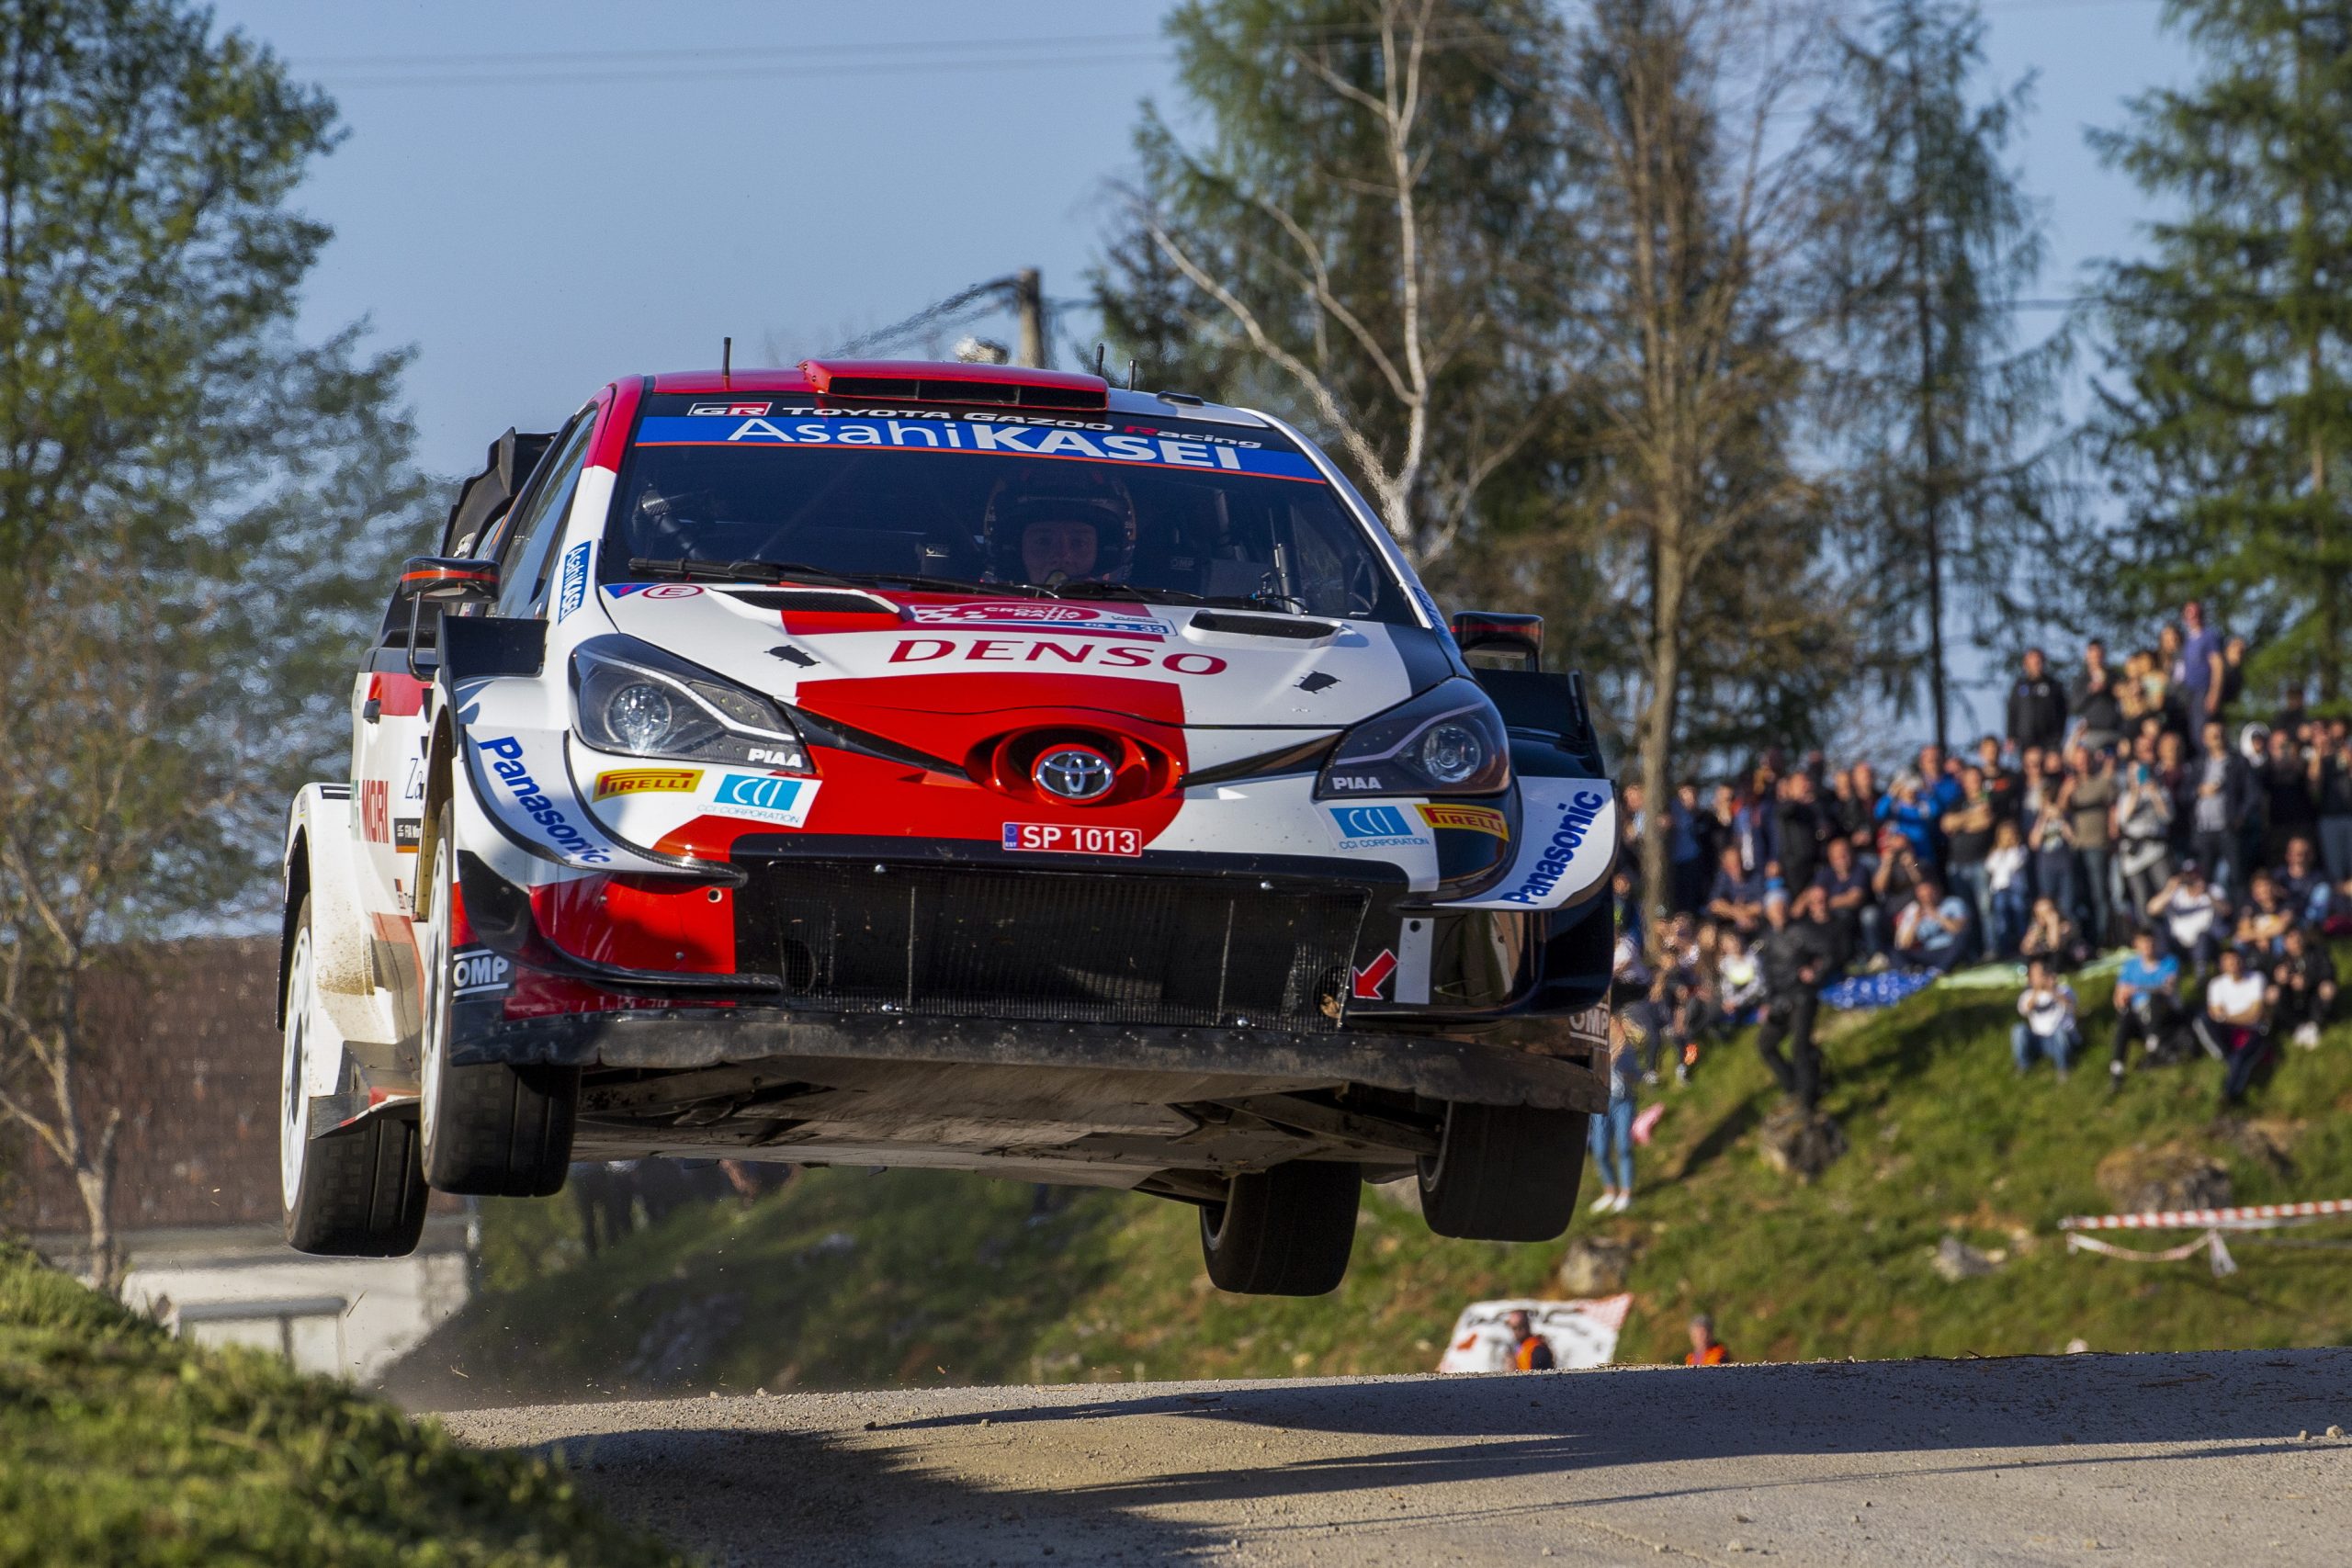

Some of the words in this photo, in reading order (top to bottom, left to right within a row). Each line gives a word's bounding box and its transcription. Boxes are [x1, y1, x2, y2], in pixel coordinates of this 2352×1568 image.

[689, 405, 768, 416] GR
[783, 407, 952, 419] TOYOTA
[963, 412, 1114, 432] GAZOO
[1124, 425, 1262, 449] Racing
[1139, 625, 1165, 634] 33
[888, 638, 1227, 676] DENSO
[748, 748, 803, 768] PIAA
[598, 771, 695, 795] PIRELLI
[732, 778, 783, 807] CCI
[1332, 777, 1382, 790] PIAA
[478, 736, 611, 863] Panasonic
[696, 804, 720, 814] CCI
[721, 806, 800, 824] CORPORATION
[1349, 808, 1396, 835] CCI
[1423, 807, 1504, 834] PIRELLI
[1023, 825, 1062, 849] SP
[1070, 828, 1136, 853] 1013
[1339, 840, 1359, 850] CCI
[1360, 837, 1430, 848] CORPORATION
[1499, 791, 1603, 905] Panasonic
[453, 955, 509, 987] OMP
